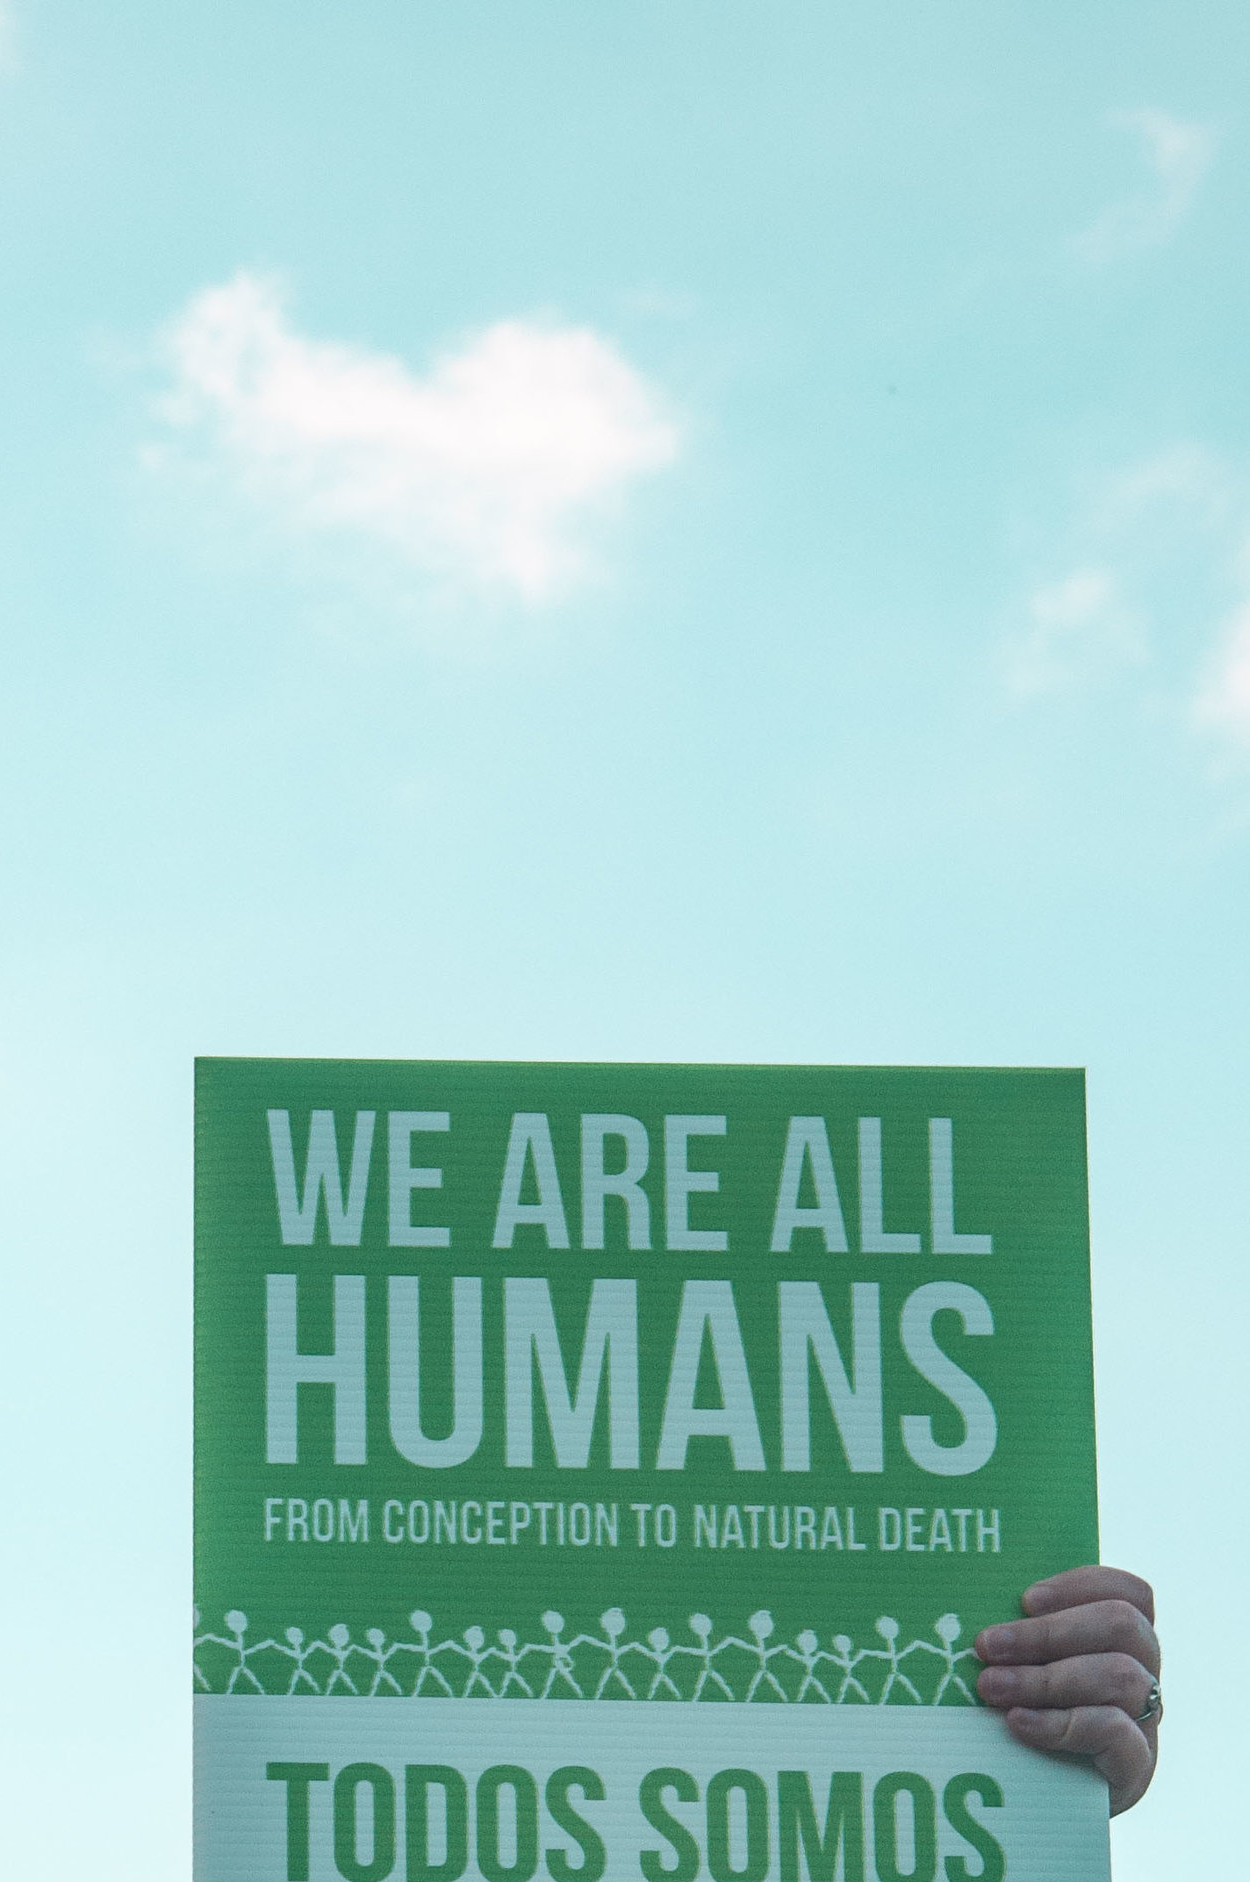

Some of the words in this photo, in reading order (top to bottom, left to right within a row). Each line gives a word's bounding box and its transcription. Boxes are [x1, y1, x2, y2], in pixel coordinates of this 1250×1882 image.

[266, 1109, 452, 1247] WE
[492, 1113, 728, 1251] ARE
[770, 1116, 995, 1255] ALL
[264, 1274, 999, 1476] HUMANS
[264, 1498, 369, 1543] FROM
[383, 1500, 618, 1547] CONCEPTION
[630, 1503, 677, 1548] TO
[694, 1504, 866, 1551] NATURAL
[879, 1507, 1001, 1553] DEATH
